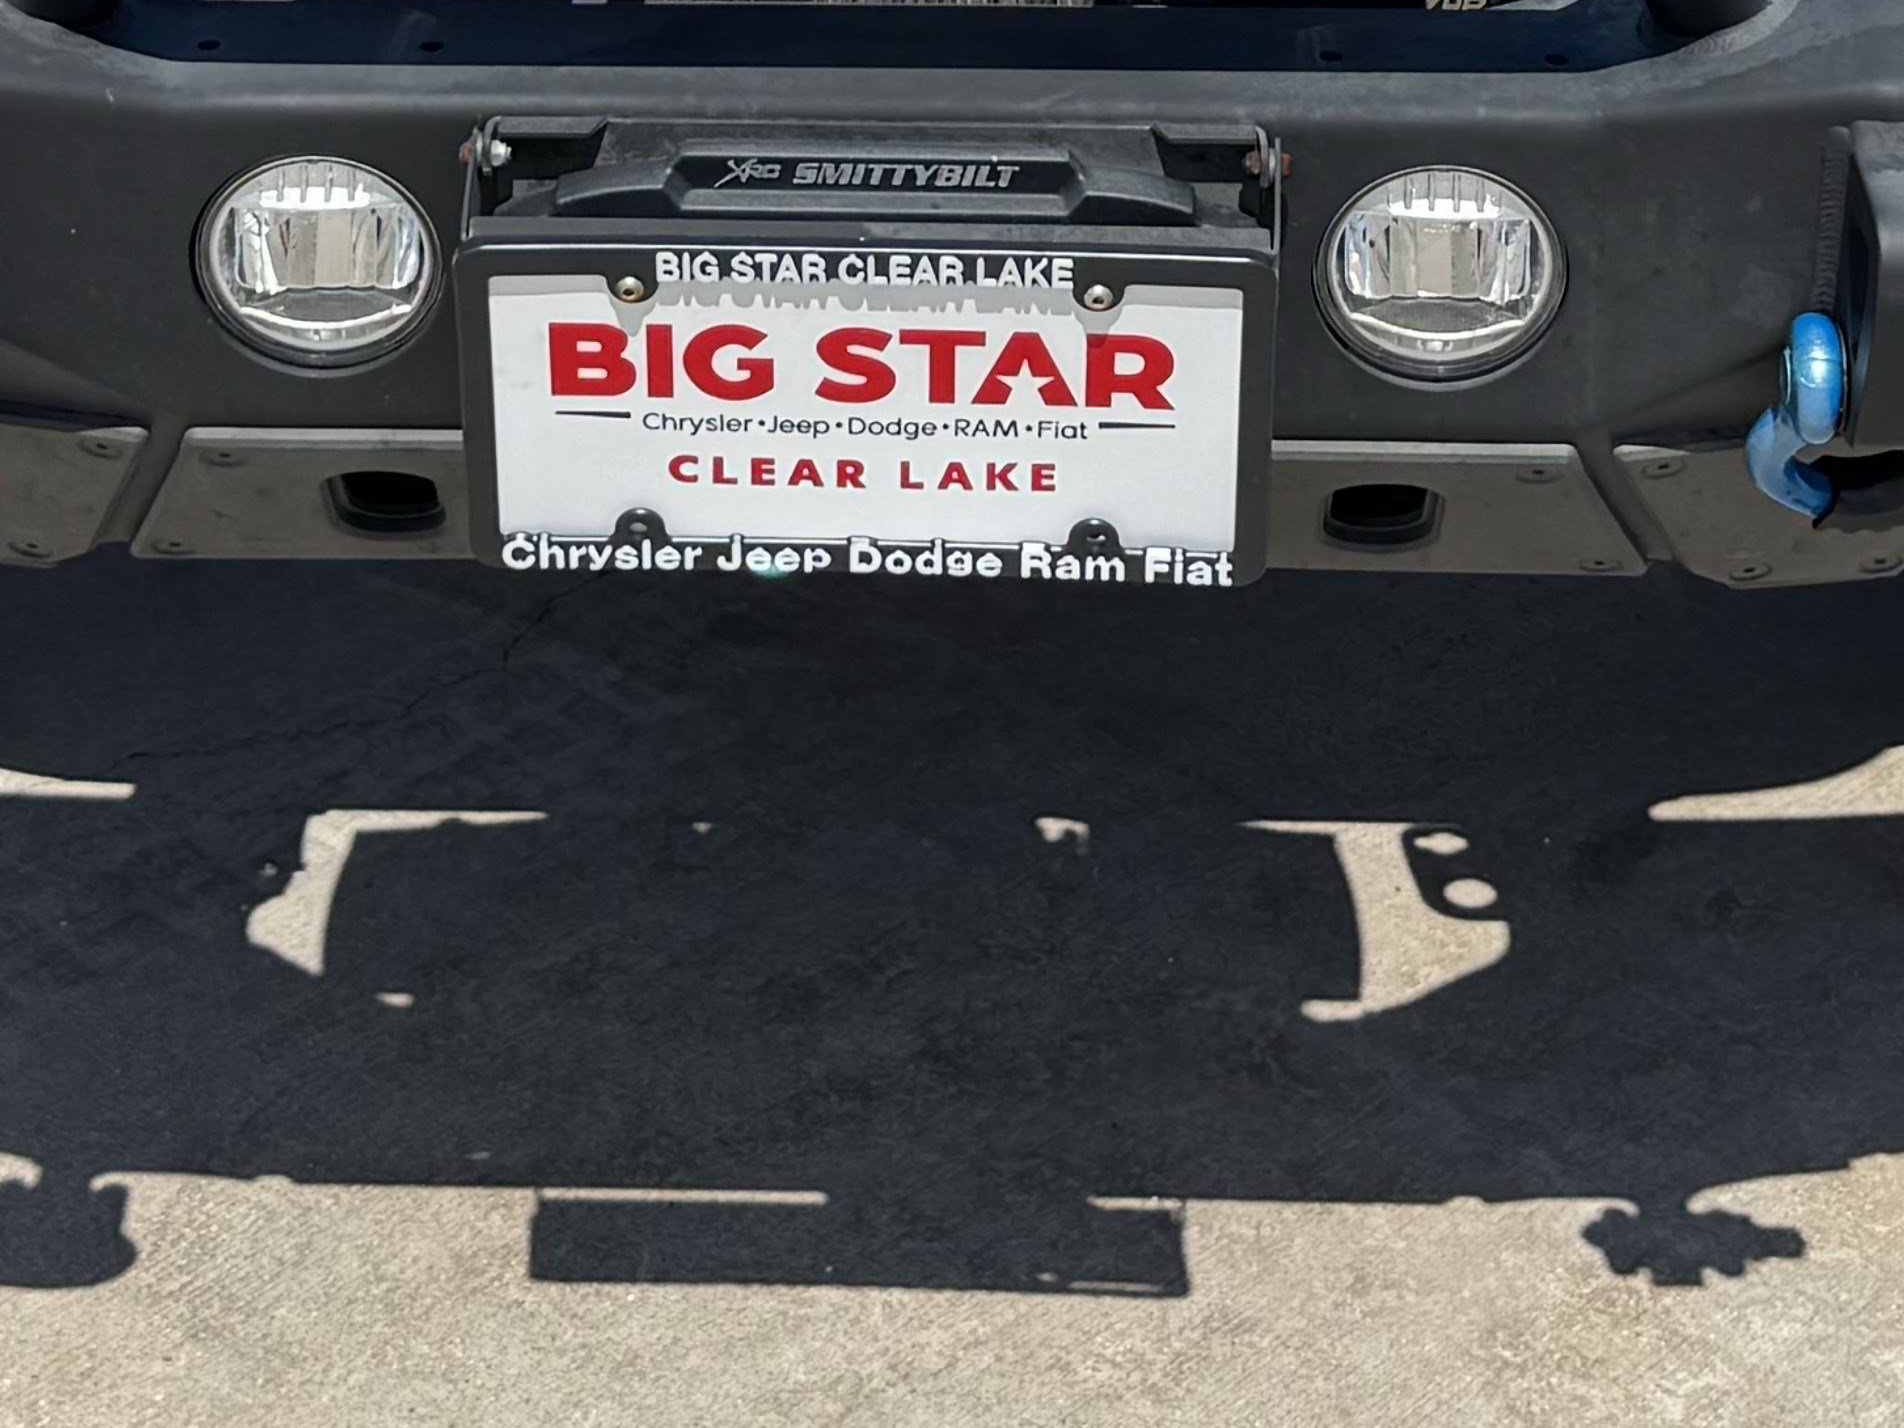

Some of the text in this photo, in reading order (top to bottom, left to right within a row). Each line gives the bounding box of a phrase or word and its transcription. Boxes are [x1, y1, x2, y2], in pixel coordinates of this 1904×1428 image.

[793, 162, 1021, 188] SMITTYBILT
[654, 251, 1075, 290] BIG STAR CLEAR LAKE
[548, 321, 1176, 411] BIG STAR
[642, 411, 1089, 441] Chrysler Jeep Dodge RAM Fiat
[667, 454, 1058, 492] CLEAR LAKE
[500, 533, 1234, 587] Chrysler Jeep Dodge Ram Fiat
